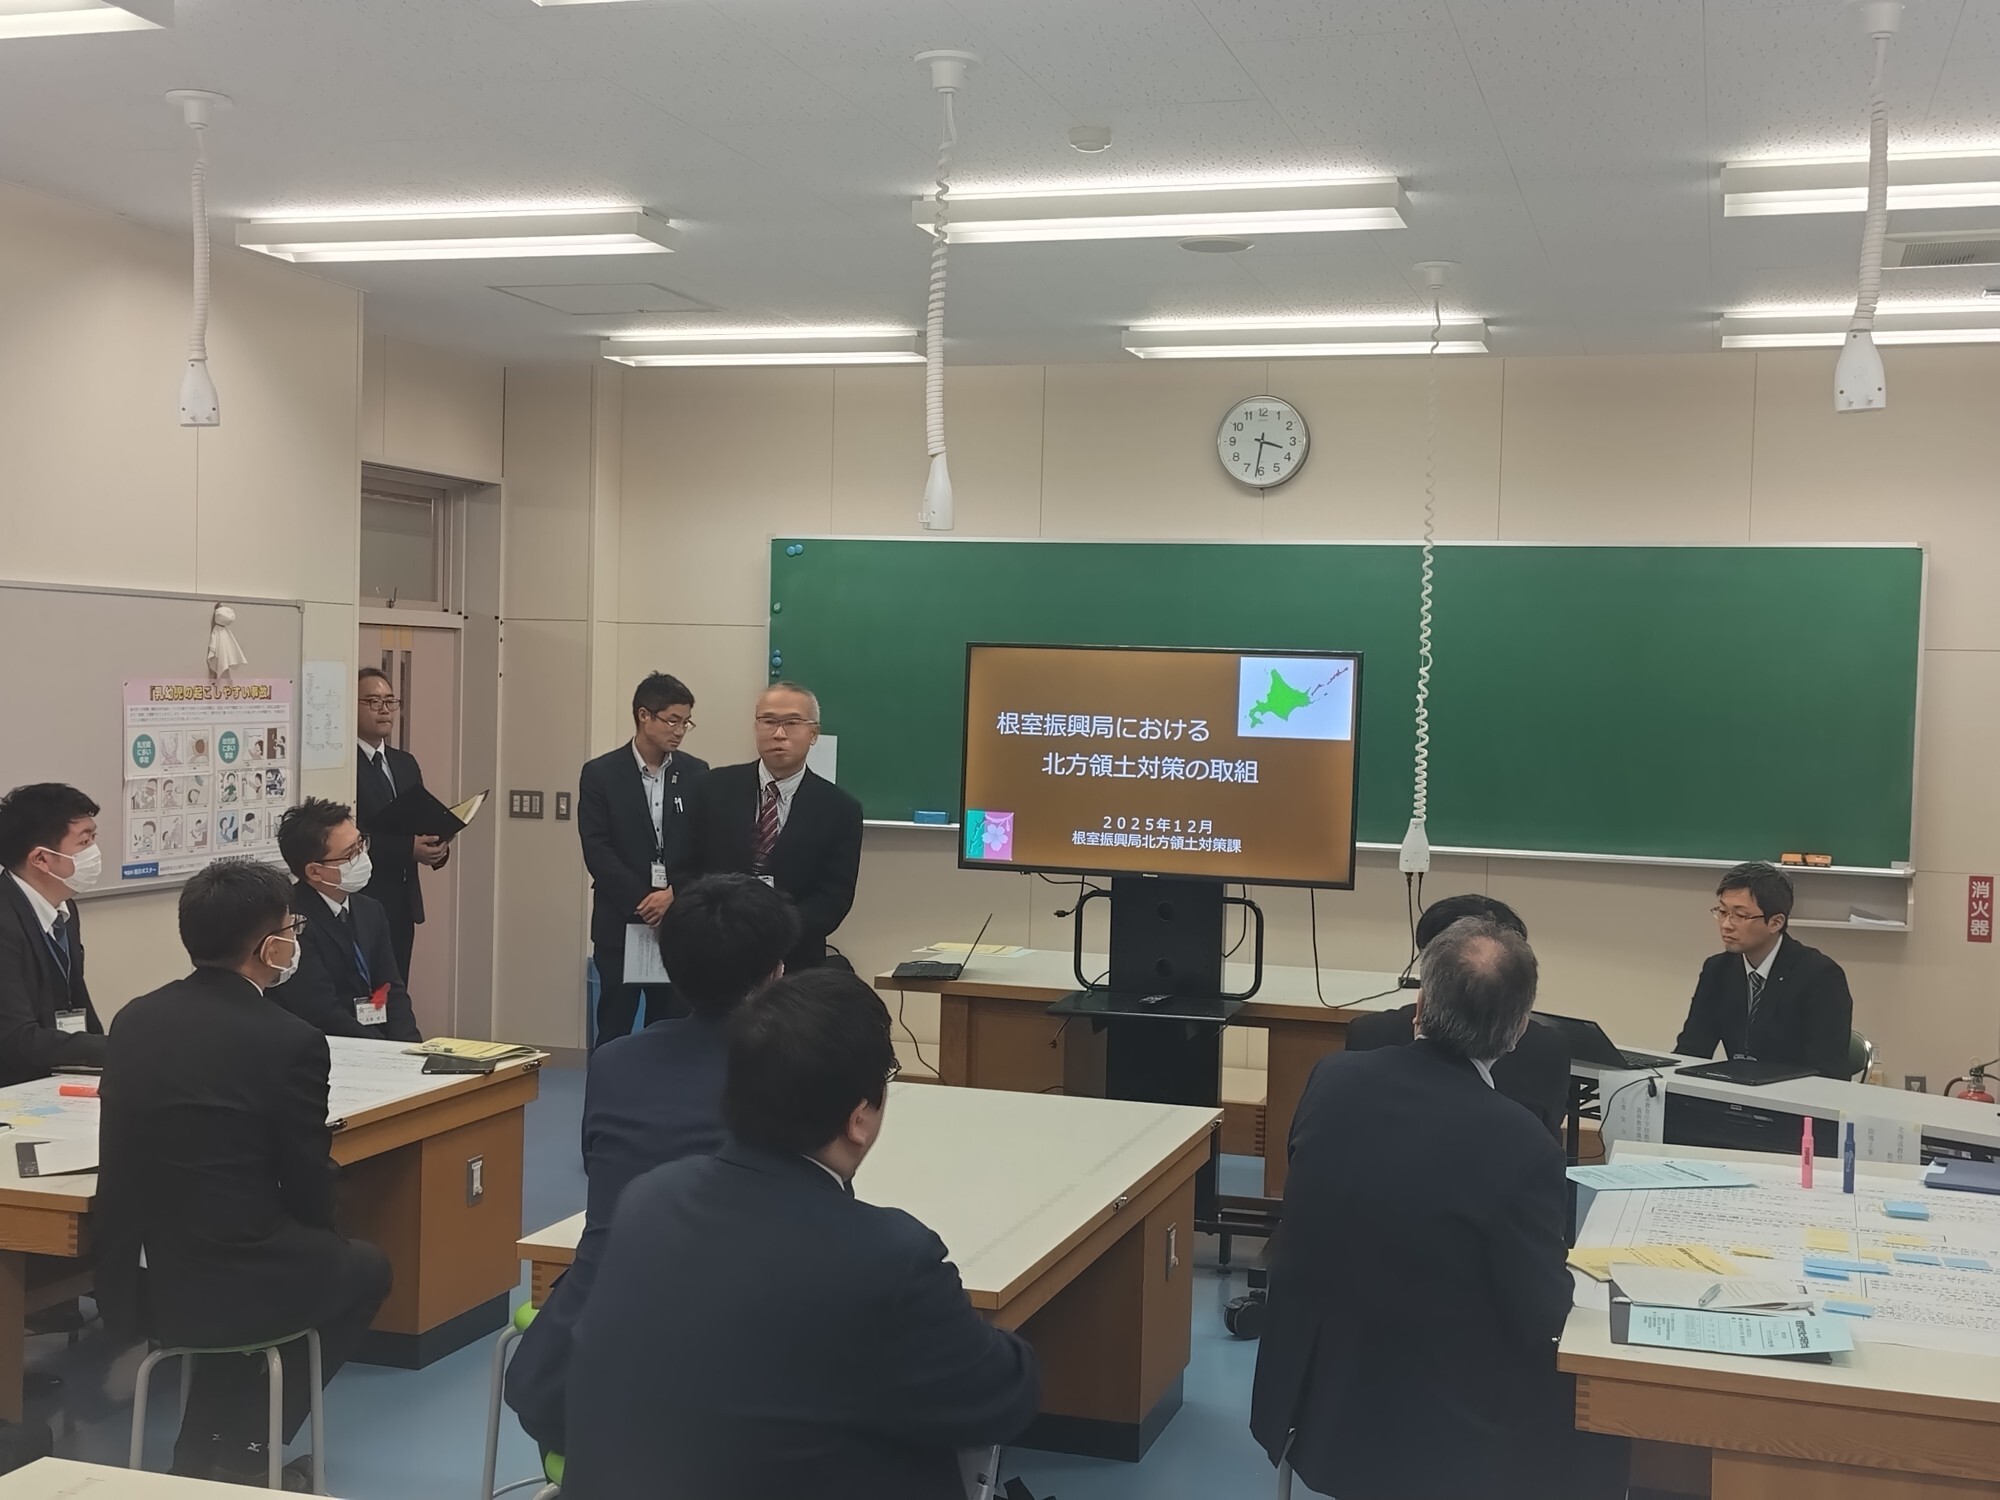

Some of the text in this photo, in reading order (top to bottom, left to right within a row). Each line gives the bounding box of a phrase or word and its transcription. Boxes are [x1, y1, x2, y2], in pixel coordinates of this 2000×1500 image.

[1244, 410, 1253, 420] 11
[1258, 407, 1269, 417] 12
[1276, 410, 1281, 420] 1
[1233, 422, 1244, 432] 10
[1285, 421, 1293, 431] 2
[1229, 436, 1237, 446] 9
[1289, 436, 1297, 446] 3
[1232, 452, 1240, 462] 8
[1283, 452, 1291, 461] 4
[1243, 463, 1251, 473] 7
[1258, 466, 1265, 476] 6
[1273, 463, 1280, 473] 5
[996, 711, 1211, 742] 根室振興局における
[1041, 752, 1260, 784] 北方領土対策の取組
[1072, 831, 1243, 854] 根室振興局北方領土対策課
[1969, 881, 1990, 937] 消火器
